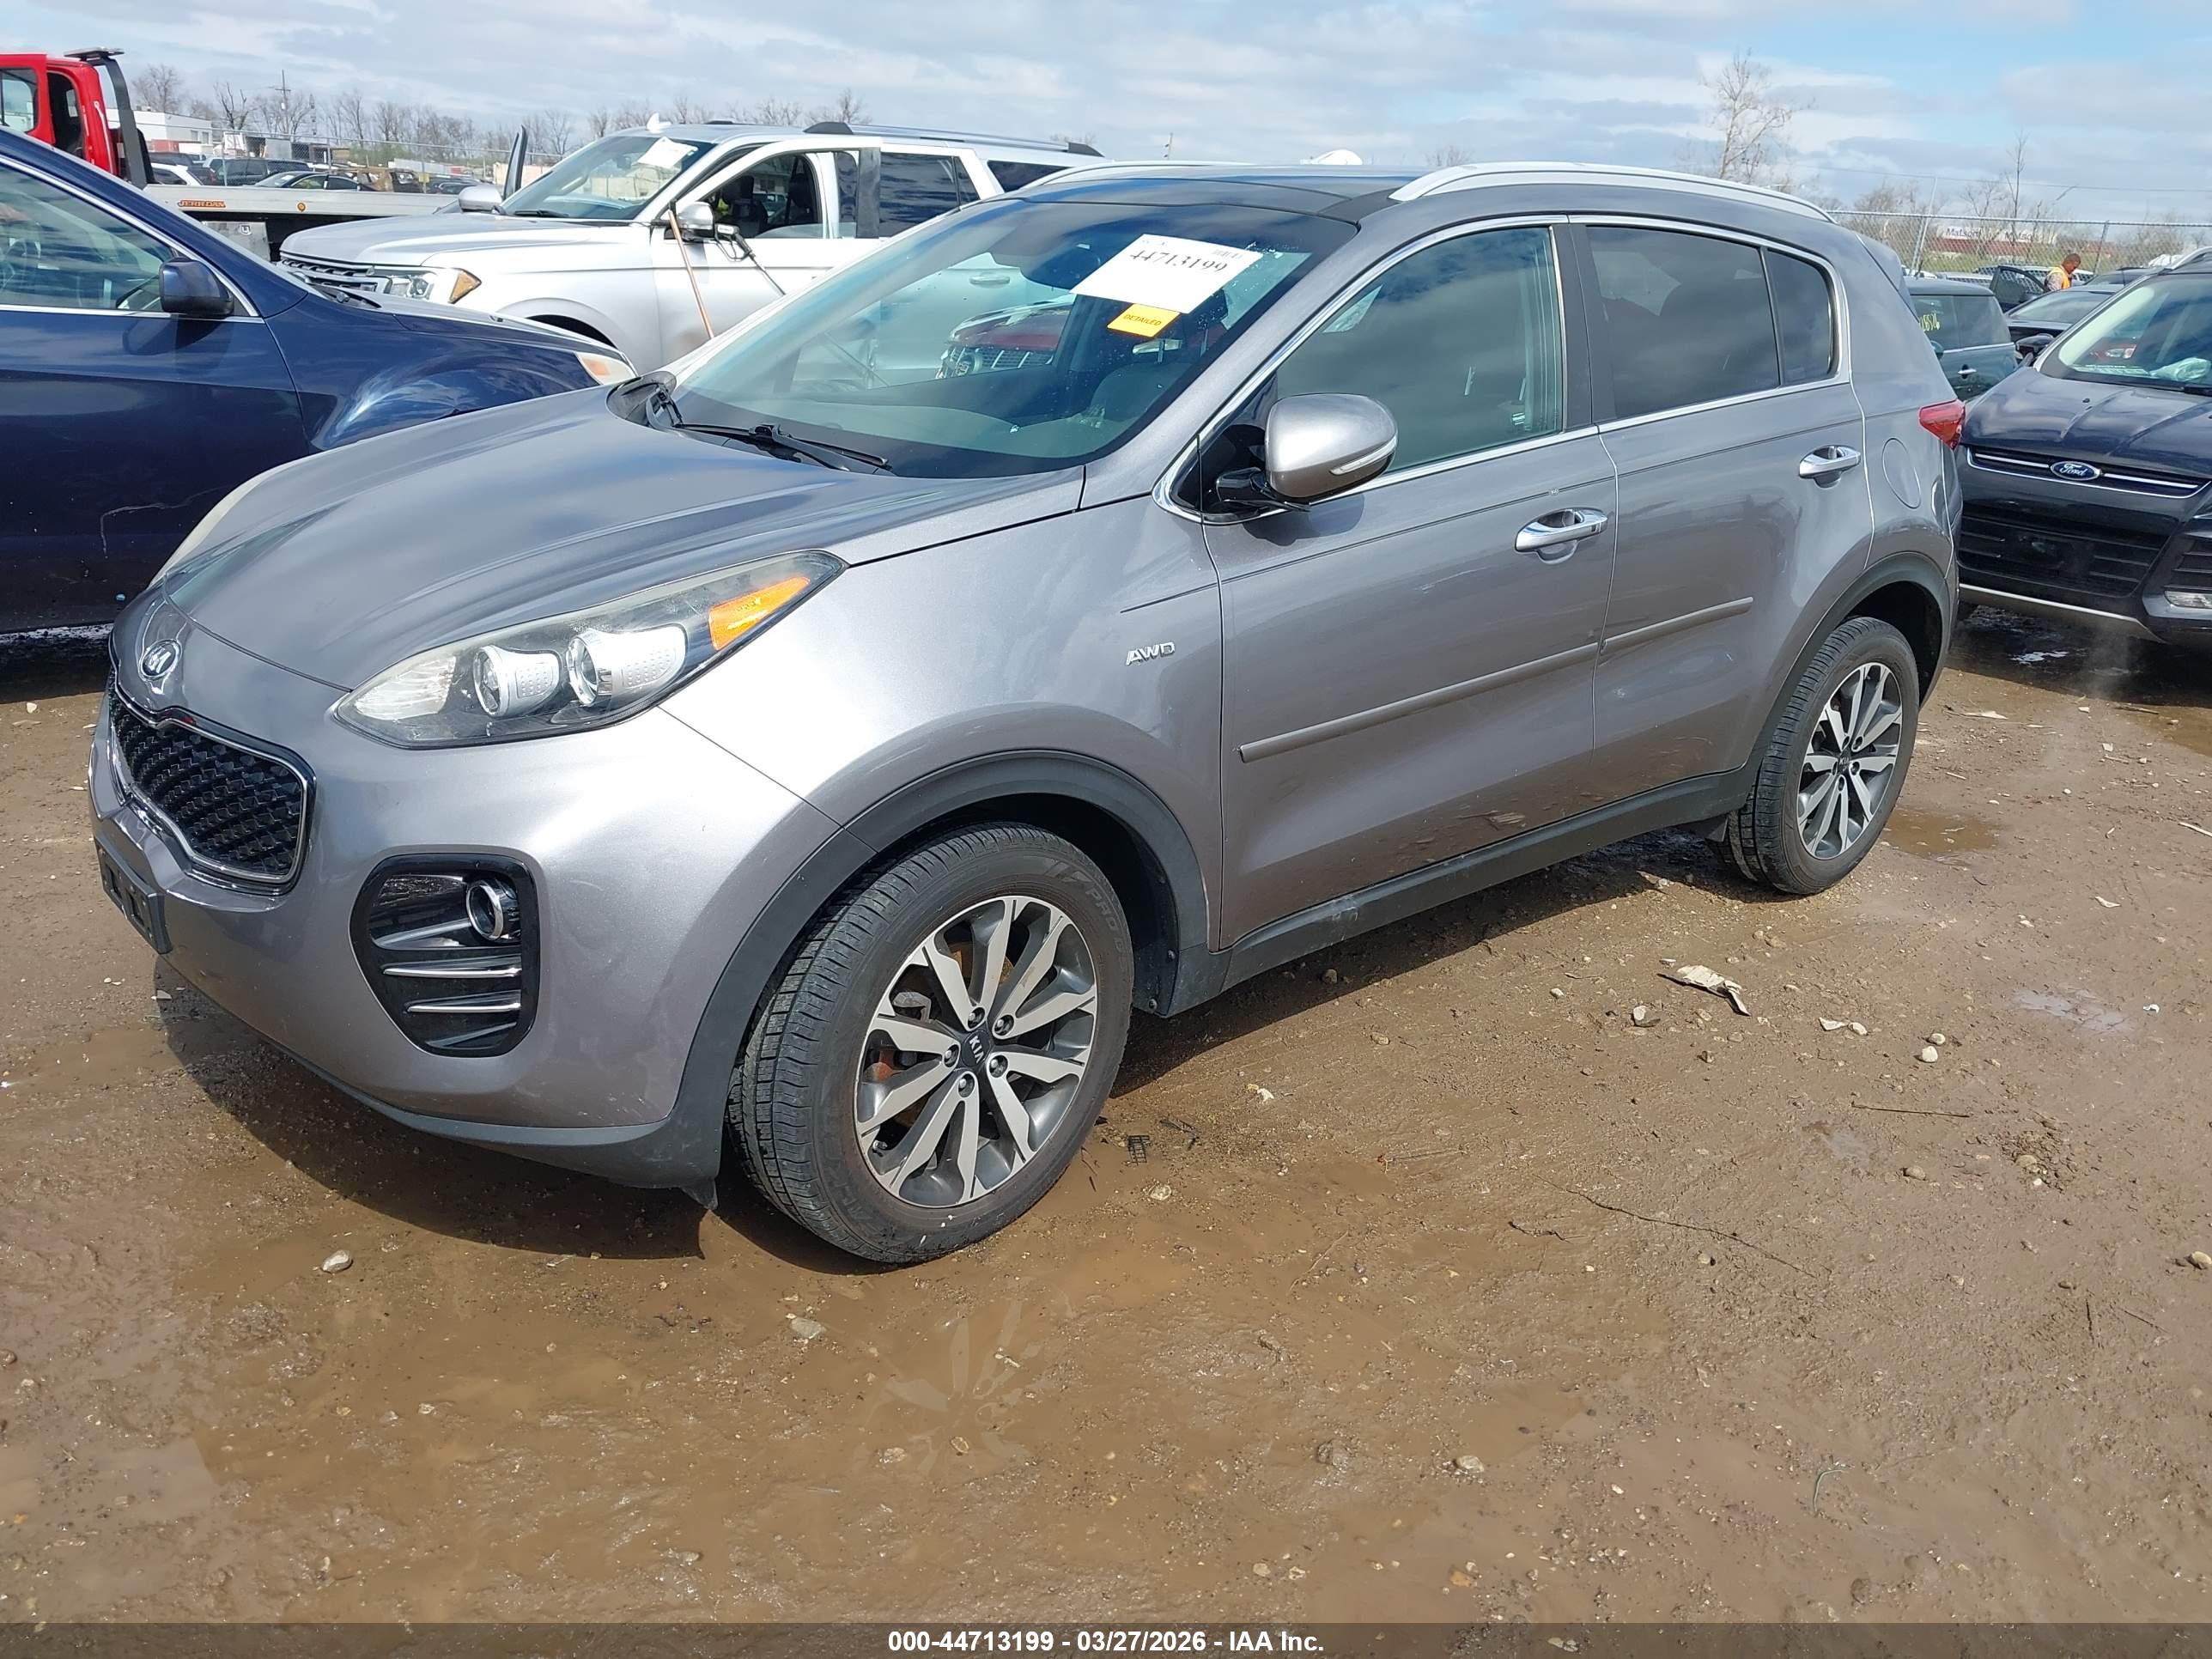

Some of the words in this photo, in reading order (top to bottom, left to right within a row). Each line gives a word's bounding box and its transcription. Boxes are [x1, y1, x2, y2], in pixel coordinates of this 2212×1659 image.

[1129, 249, 1228, 272] 44713199
[1122, 313, 1162, 326] DETAILED
[2059, 463, 2088, 477] Ford
[1126, 641, 1176, 666] AWD
[969, 1035, 985, 1064] KIA
